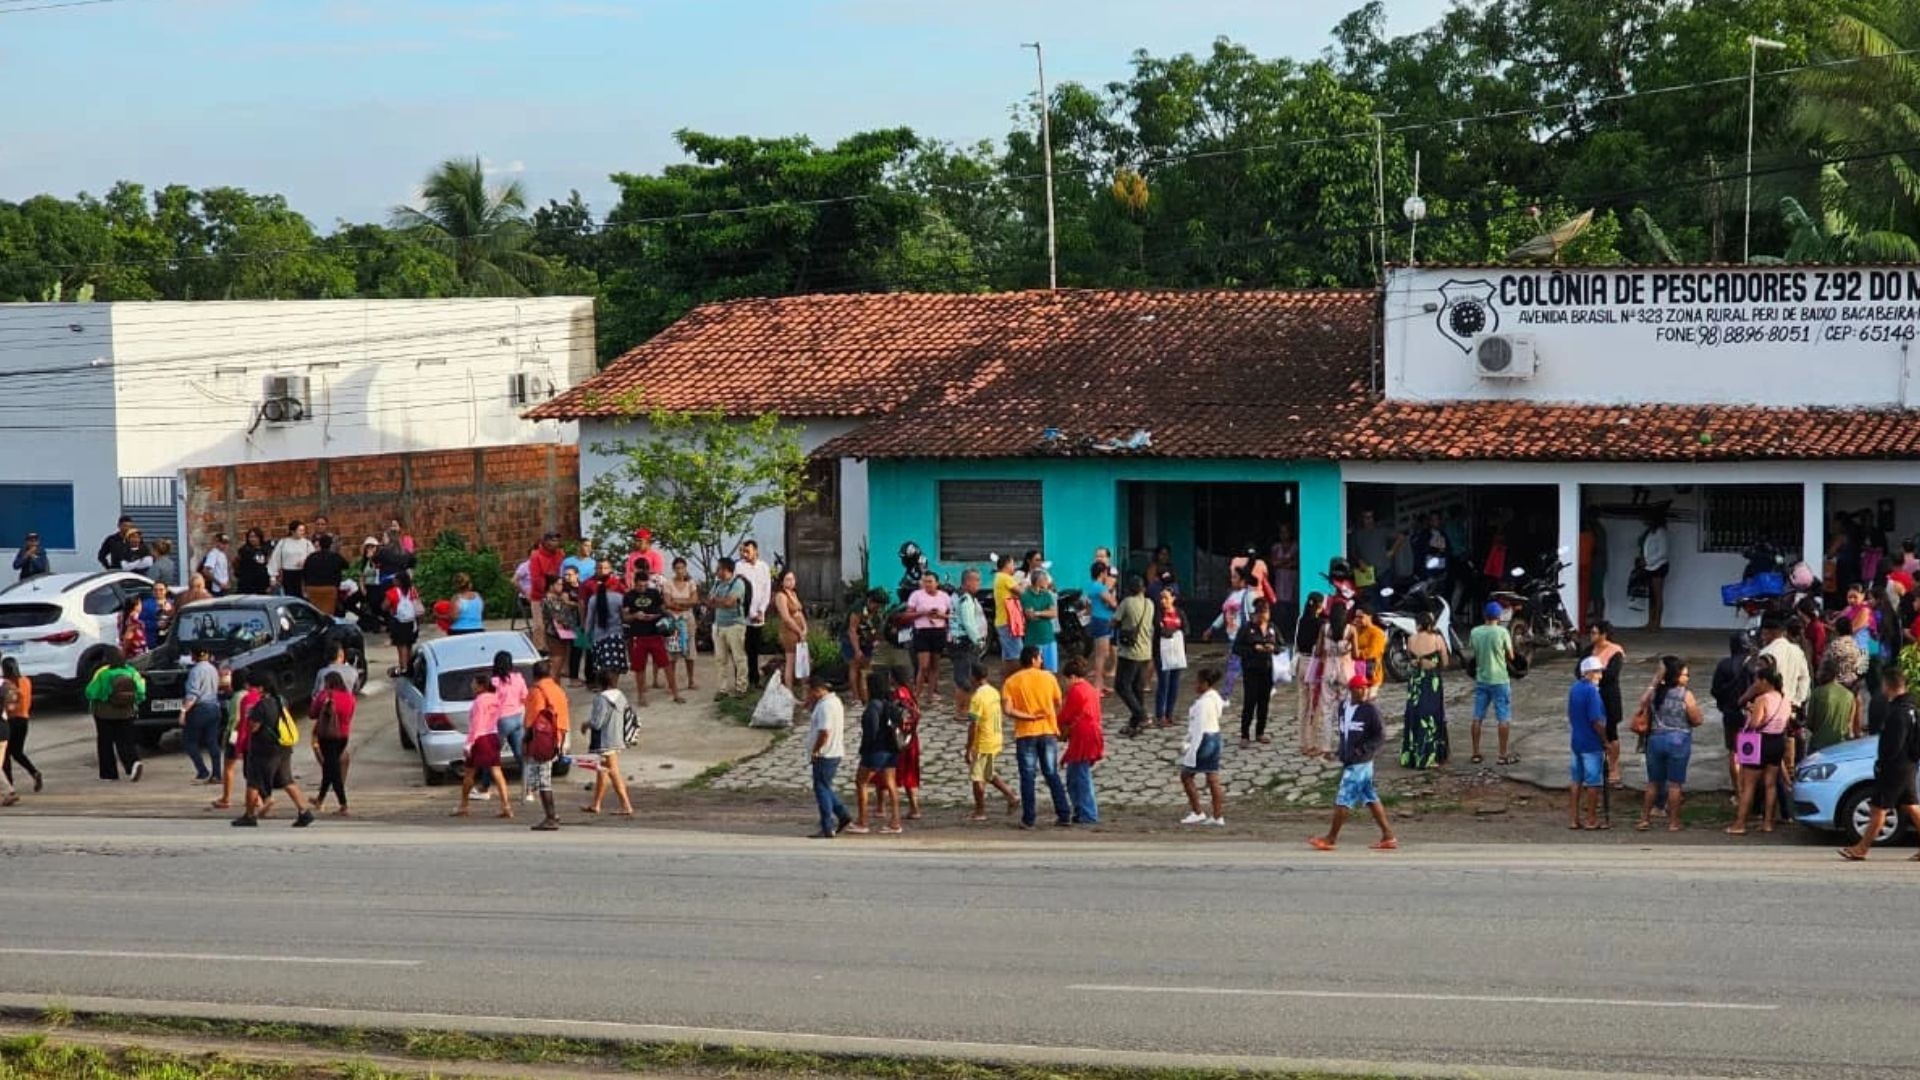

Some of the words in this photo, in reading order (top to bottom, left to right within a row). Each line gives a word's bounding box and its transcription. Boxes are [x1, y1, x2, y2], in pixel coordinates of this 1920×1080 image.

[1500, 269, 1607, 306] COLÔNIA
[1615, 274, 1645, 304] DE
[1652, 272, 1807, 304] PESCADORES
[1870, 271, 1901, 301] DO
[1519, 309, 1568, 324] AVENIDA
[1571, 308, 1617, 324] BRASIL
[1666, 308, 1703, 323] ZONA
[1707, 308, 1749, 322] RURAL
[1752, 307, 1778, 322] PERI
[1782, 306, 1796, 321] DE
[1800, 306, 1837, 321] BAIXO
